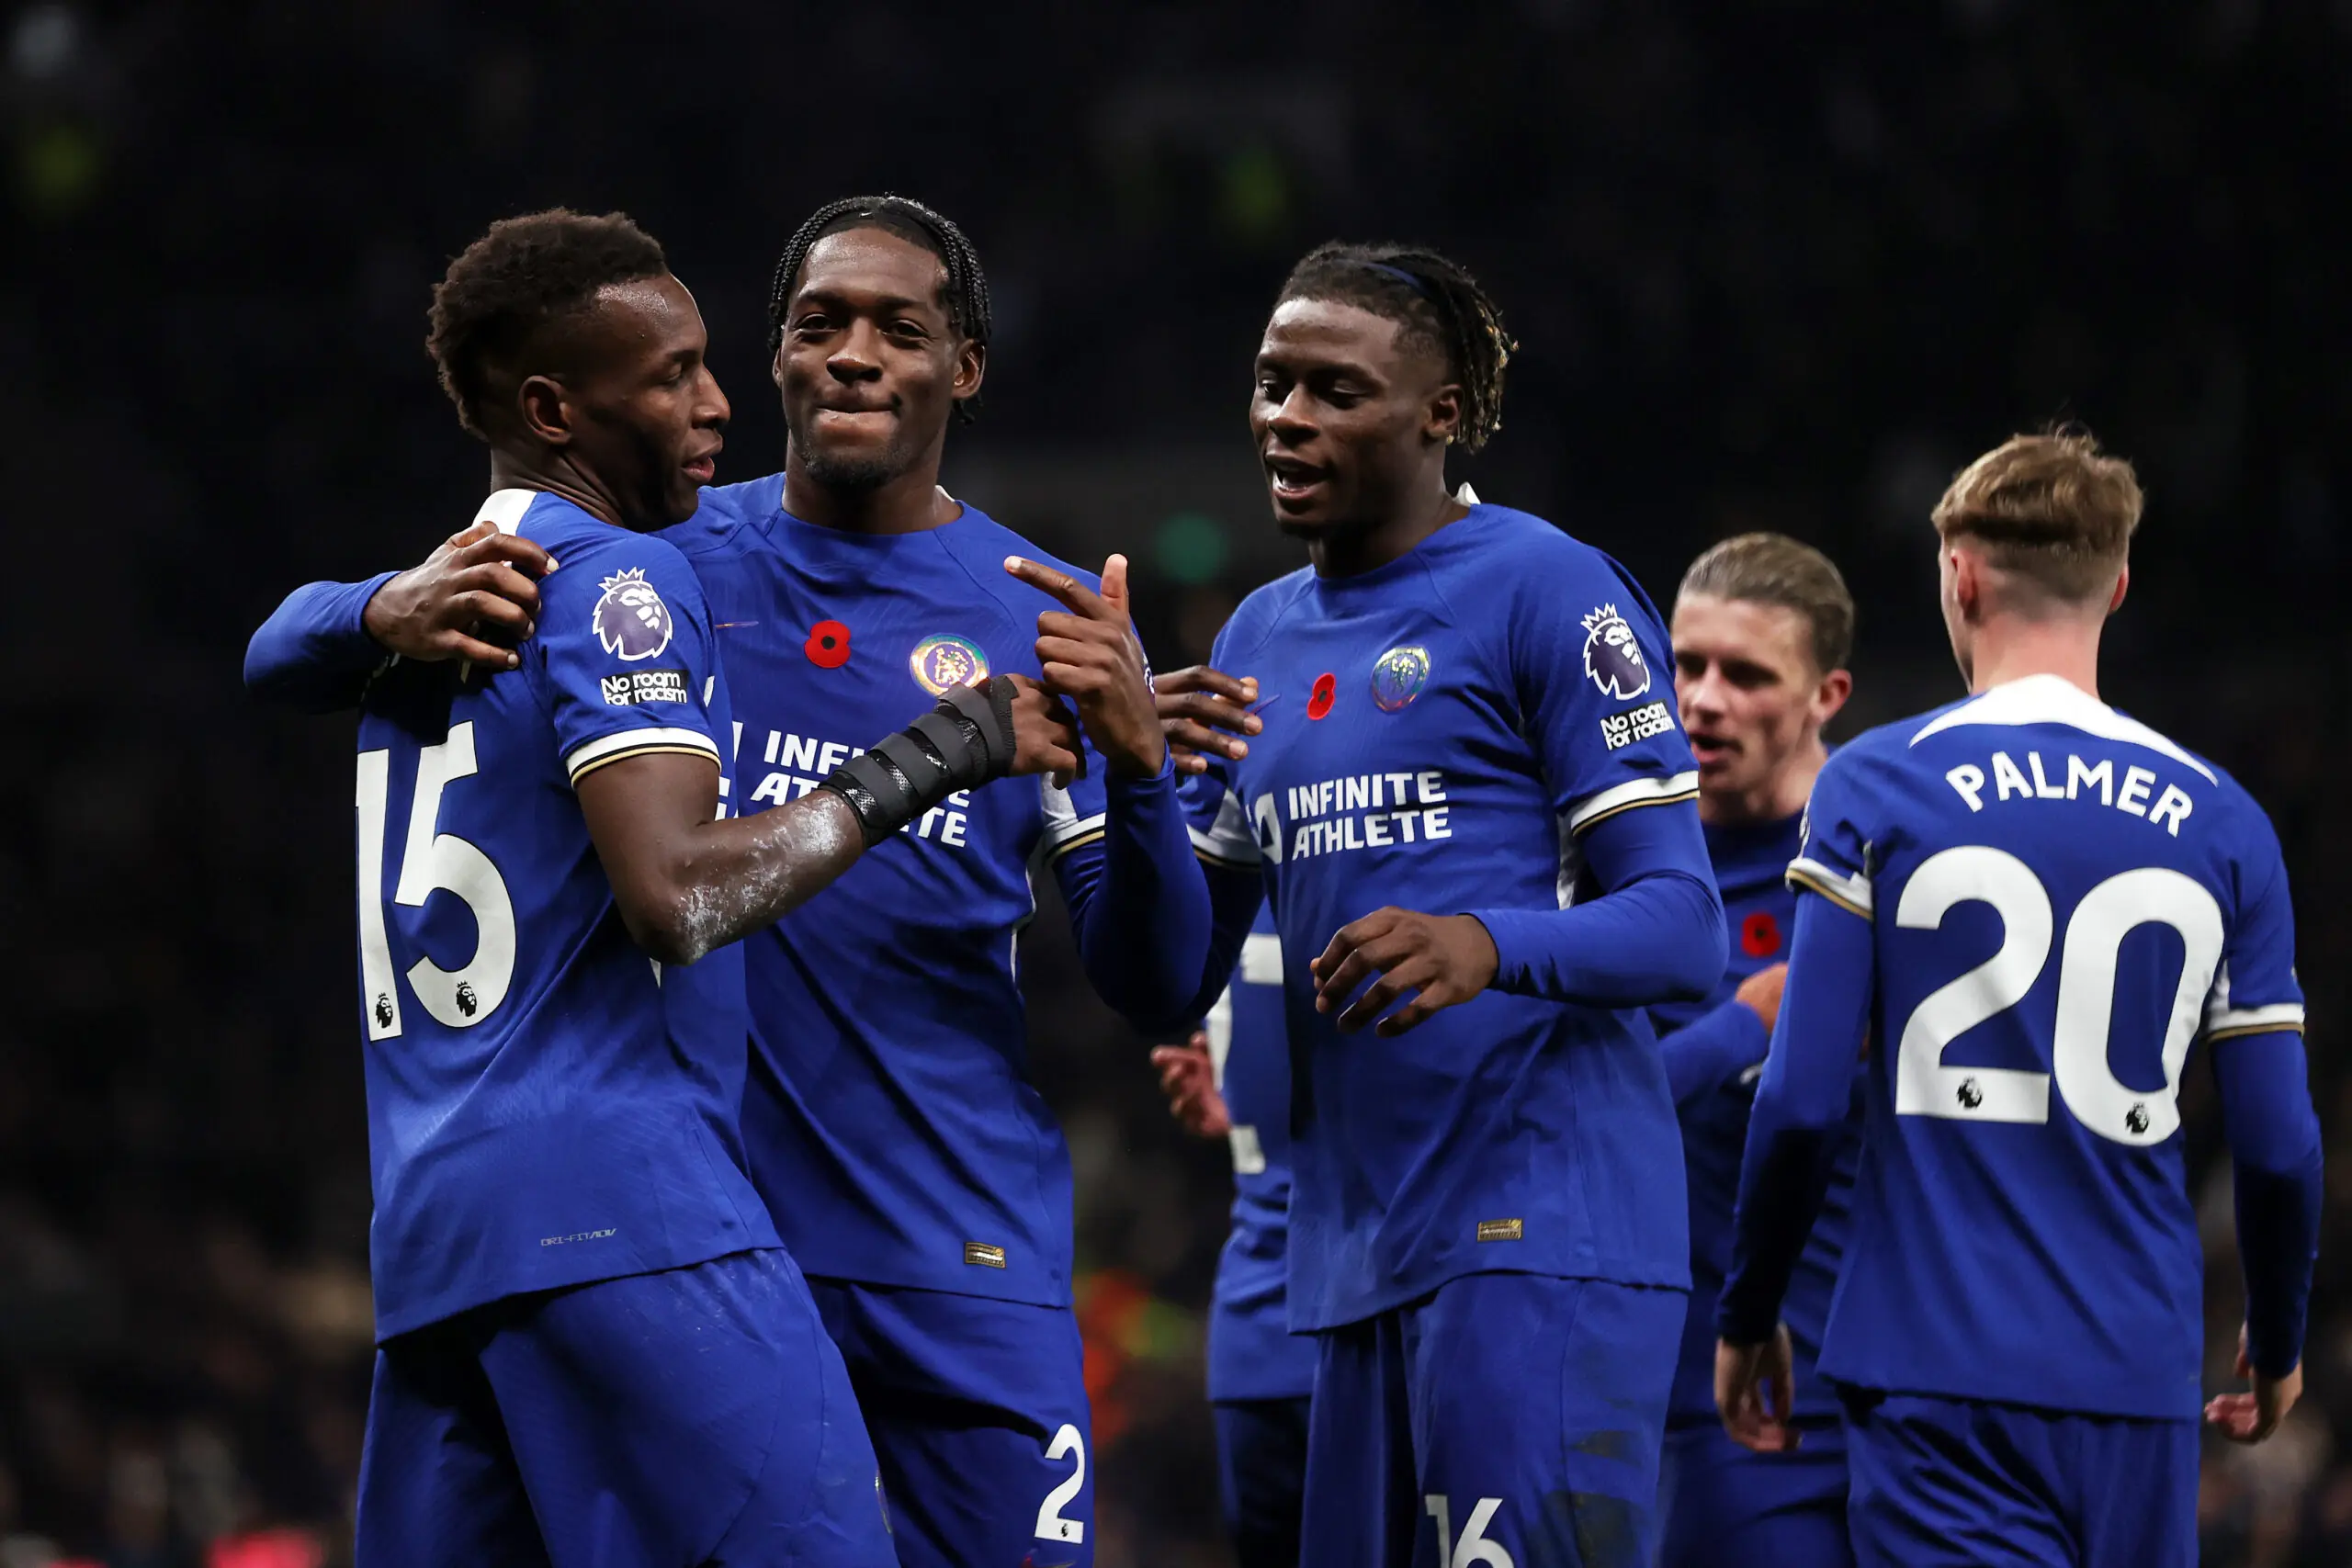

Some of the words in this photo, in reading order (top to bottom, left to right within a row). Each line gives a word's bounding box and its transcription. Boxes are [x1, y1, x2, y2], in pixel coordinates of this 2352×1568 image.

[600, 675, 630, 694] No
[632, 672, 681, 689] room
[634, 687, 687, 704] racism
[1600, 715, 1628, 737] No
[1288, 771, 1447, 820] INFINITE
[1945, 750, 2193, 838] PALMER
[1292, 806, 1453, 861] ATHLETE
[356, 720, 516, 1042] 15
[1895, 845, 2224, 1146] 20
[1035, 1423, 1085, 1544] 2
